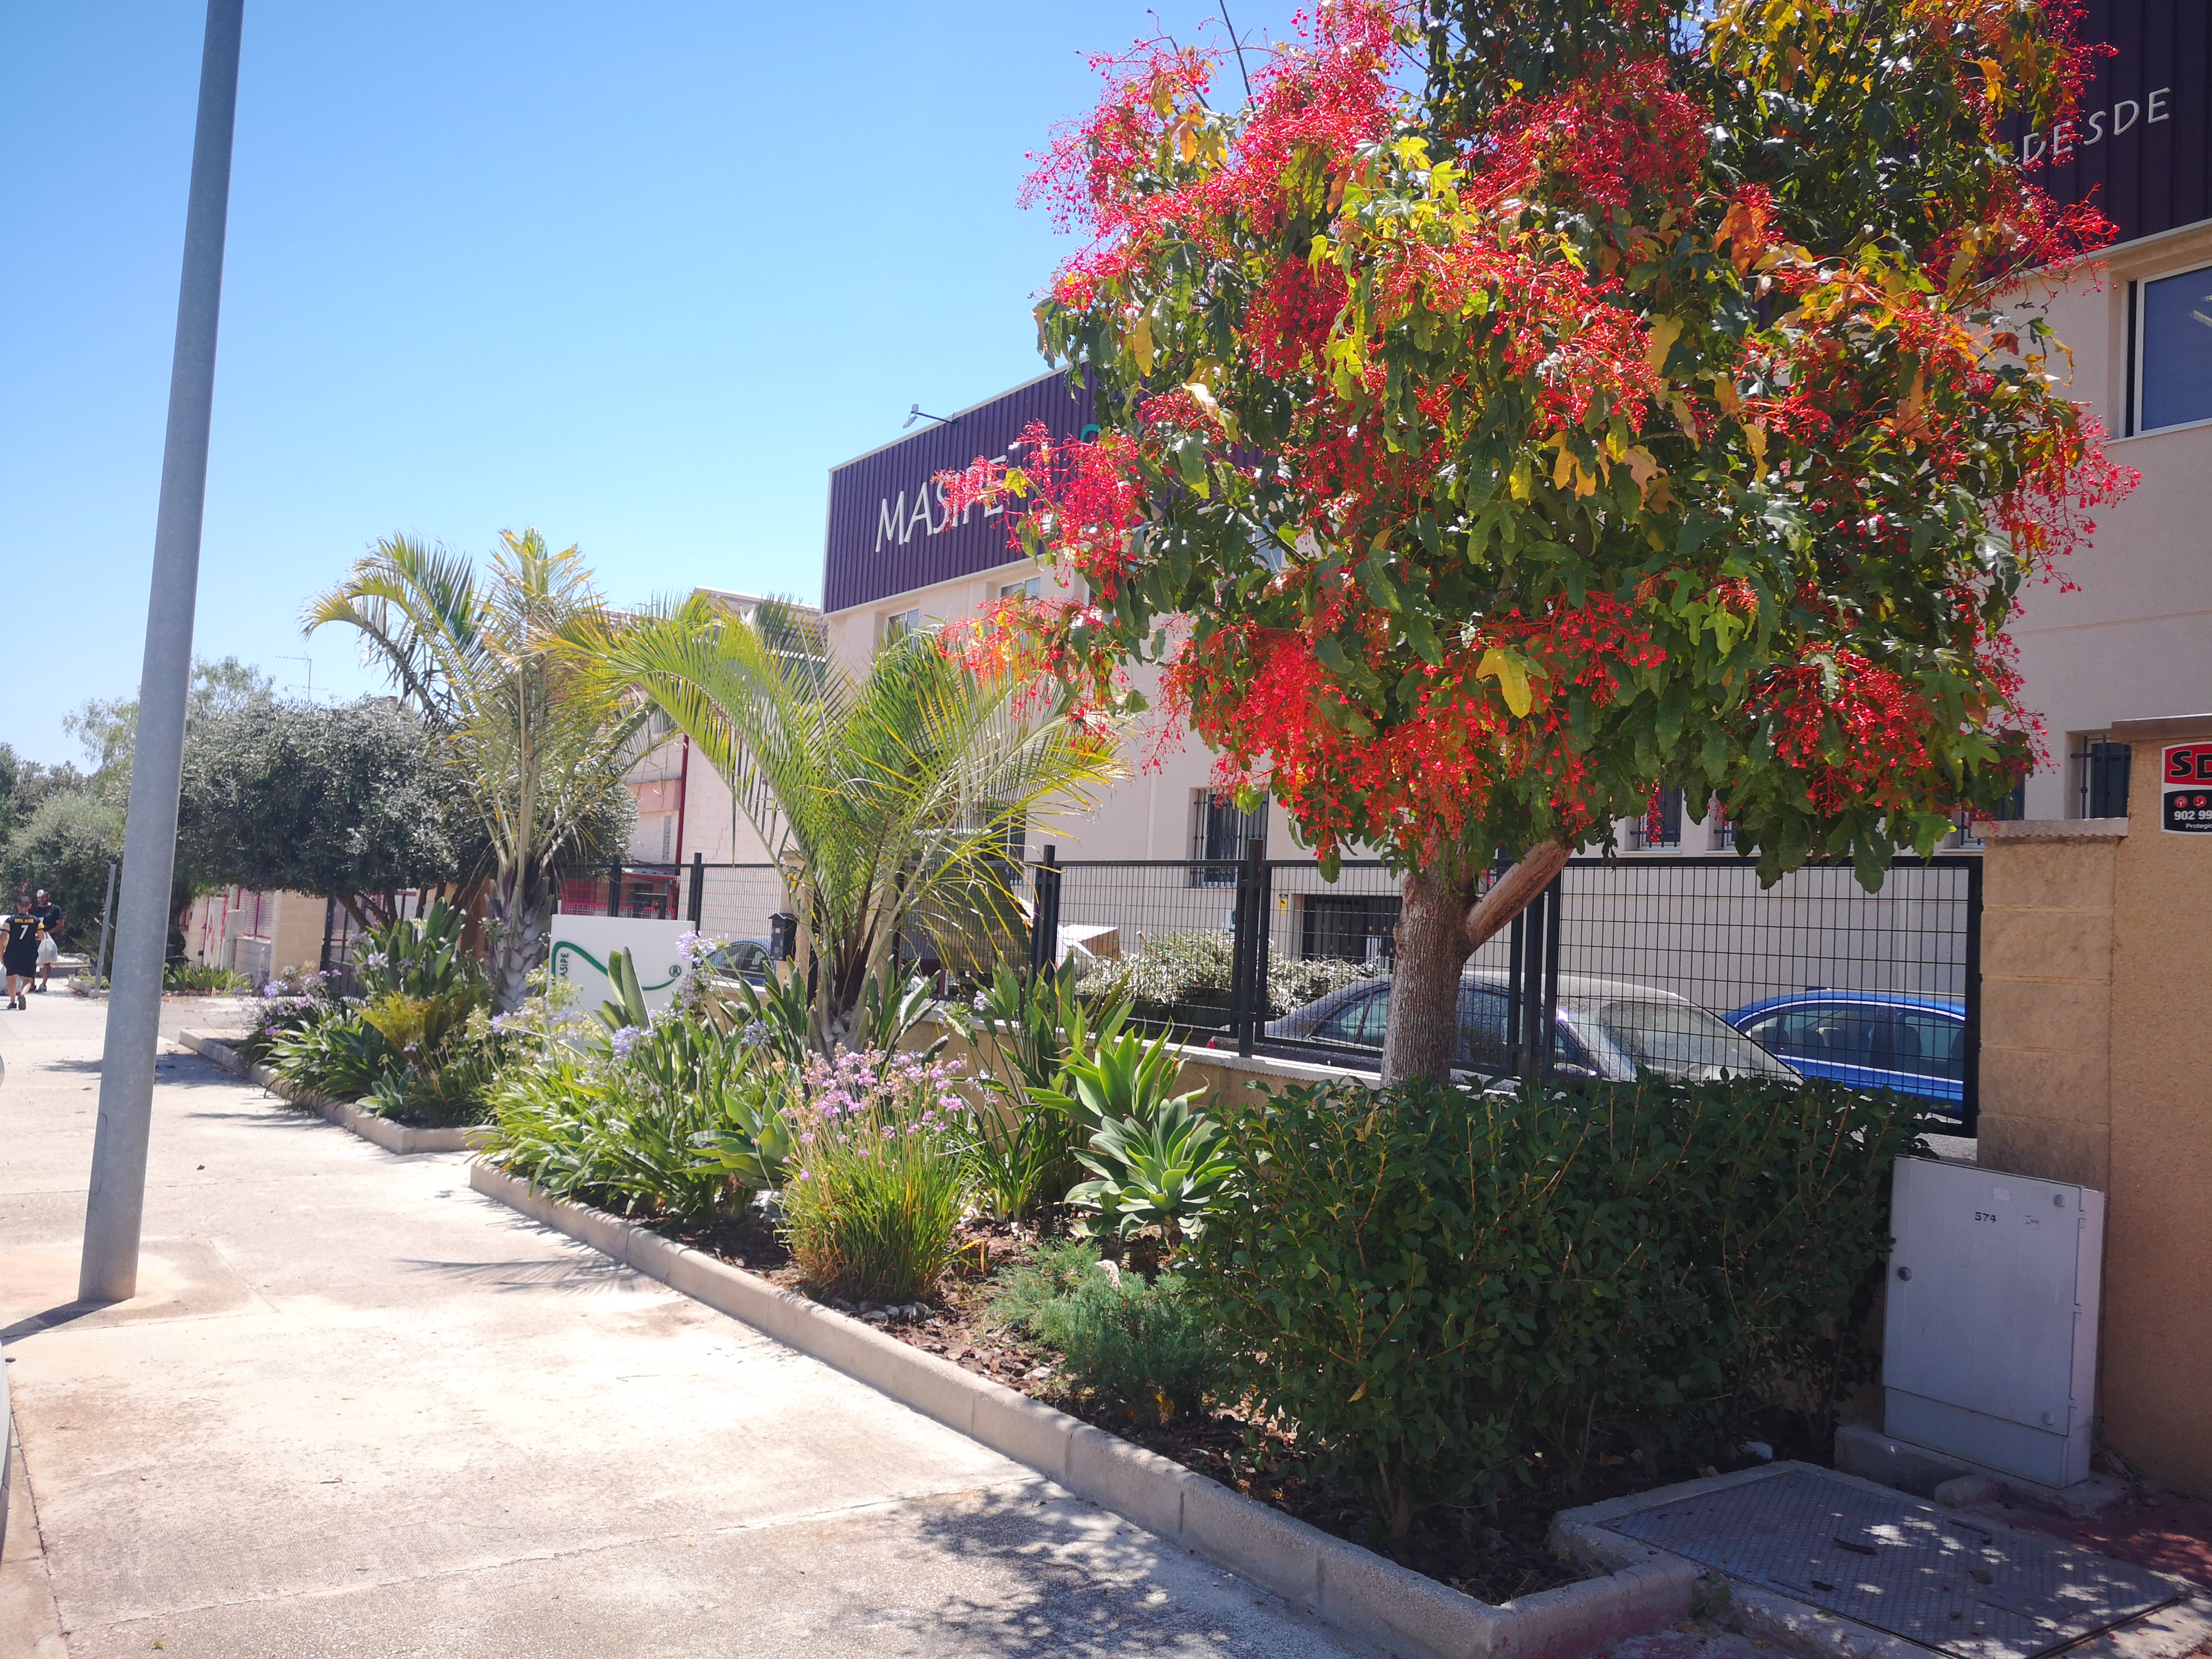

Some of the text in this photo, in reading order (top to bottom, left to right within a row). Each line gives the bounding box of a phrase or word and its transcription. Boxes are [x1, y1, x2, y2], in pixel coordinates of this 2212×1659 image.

[2023, 87, 2171, 165] DESDE
[2174, 810, 2212, 820] 902 99
[19, 925, 29, 940] 7
[559, 952, 569, 979] ASIPE
[1974, 1211, 1997, 1223] 574
